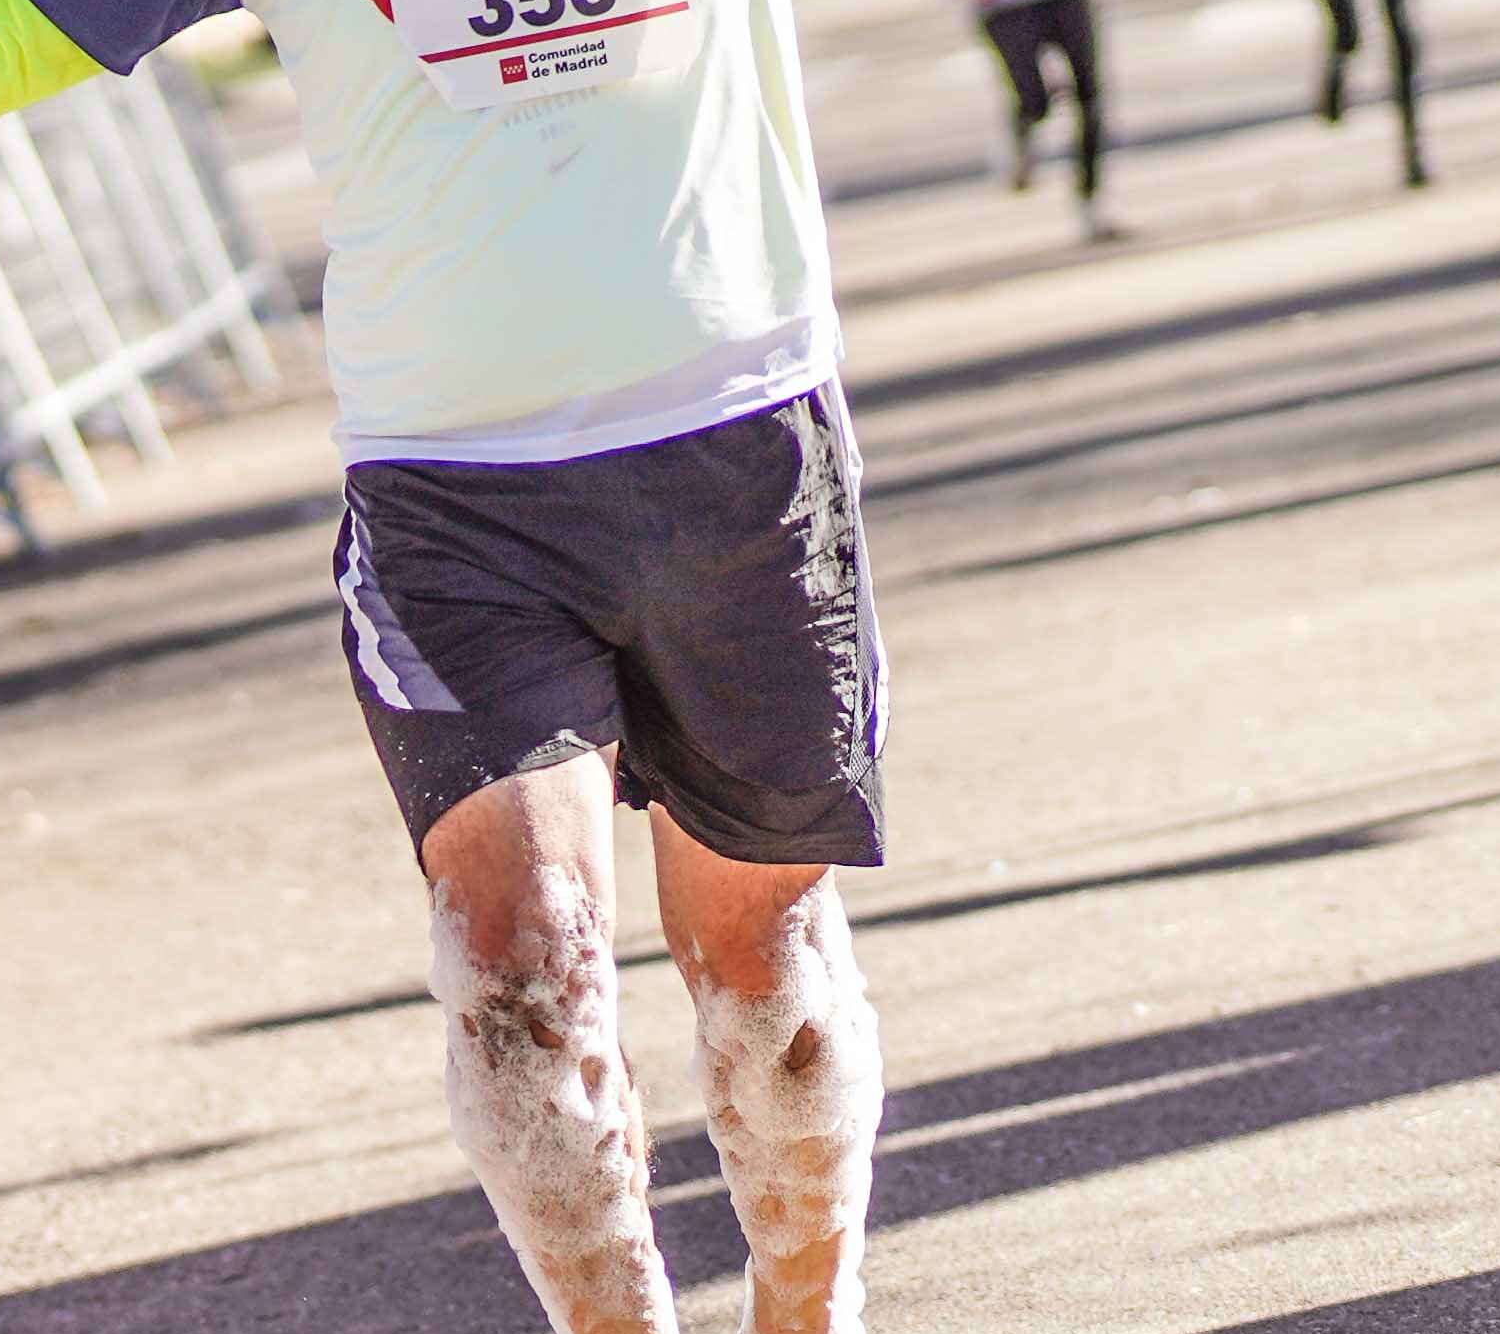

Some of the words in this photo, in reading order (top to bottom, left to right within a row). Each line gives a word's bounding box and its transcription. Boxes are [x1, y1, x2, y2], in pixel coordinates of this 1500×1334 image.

[528, 39, 606, 64] Comunidad
[531, 67, 550, 79] de
[555, 54, 608, 75] Madrid
